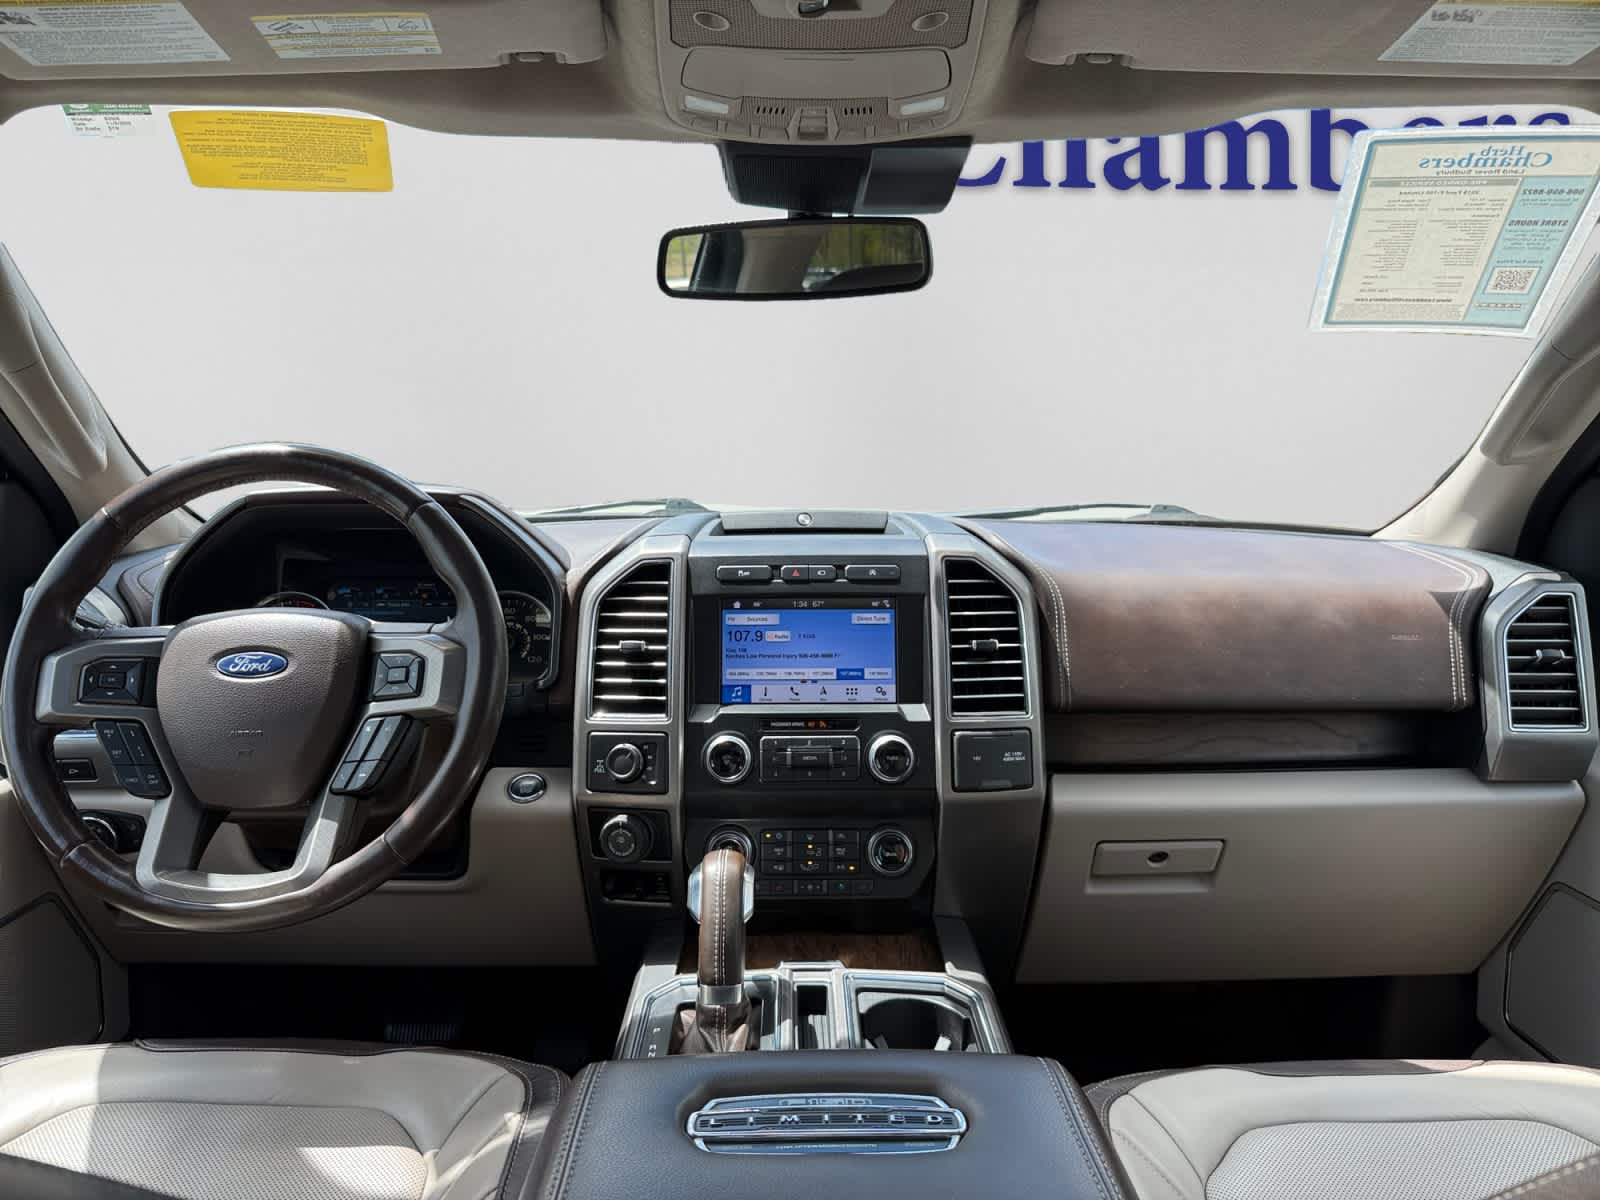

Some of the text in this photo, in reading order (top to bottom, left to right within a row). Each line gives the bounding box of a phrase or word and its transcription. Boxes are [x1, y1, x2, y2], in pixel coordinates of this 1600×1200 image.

[727, 630, 763, 642] 107.9
[229, 655, 273, 673] Ford
[708, 1112, 944, 1127] LIMITED
